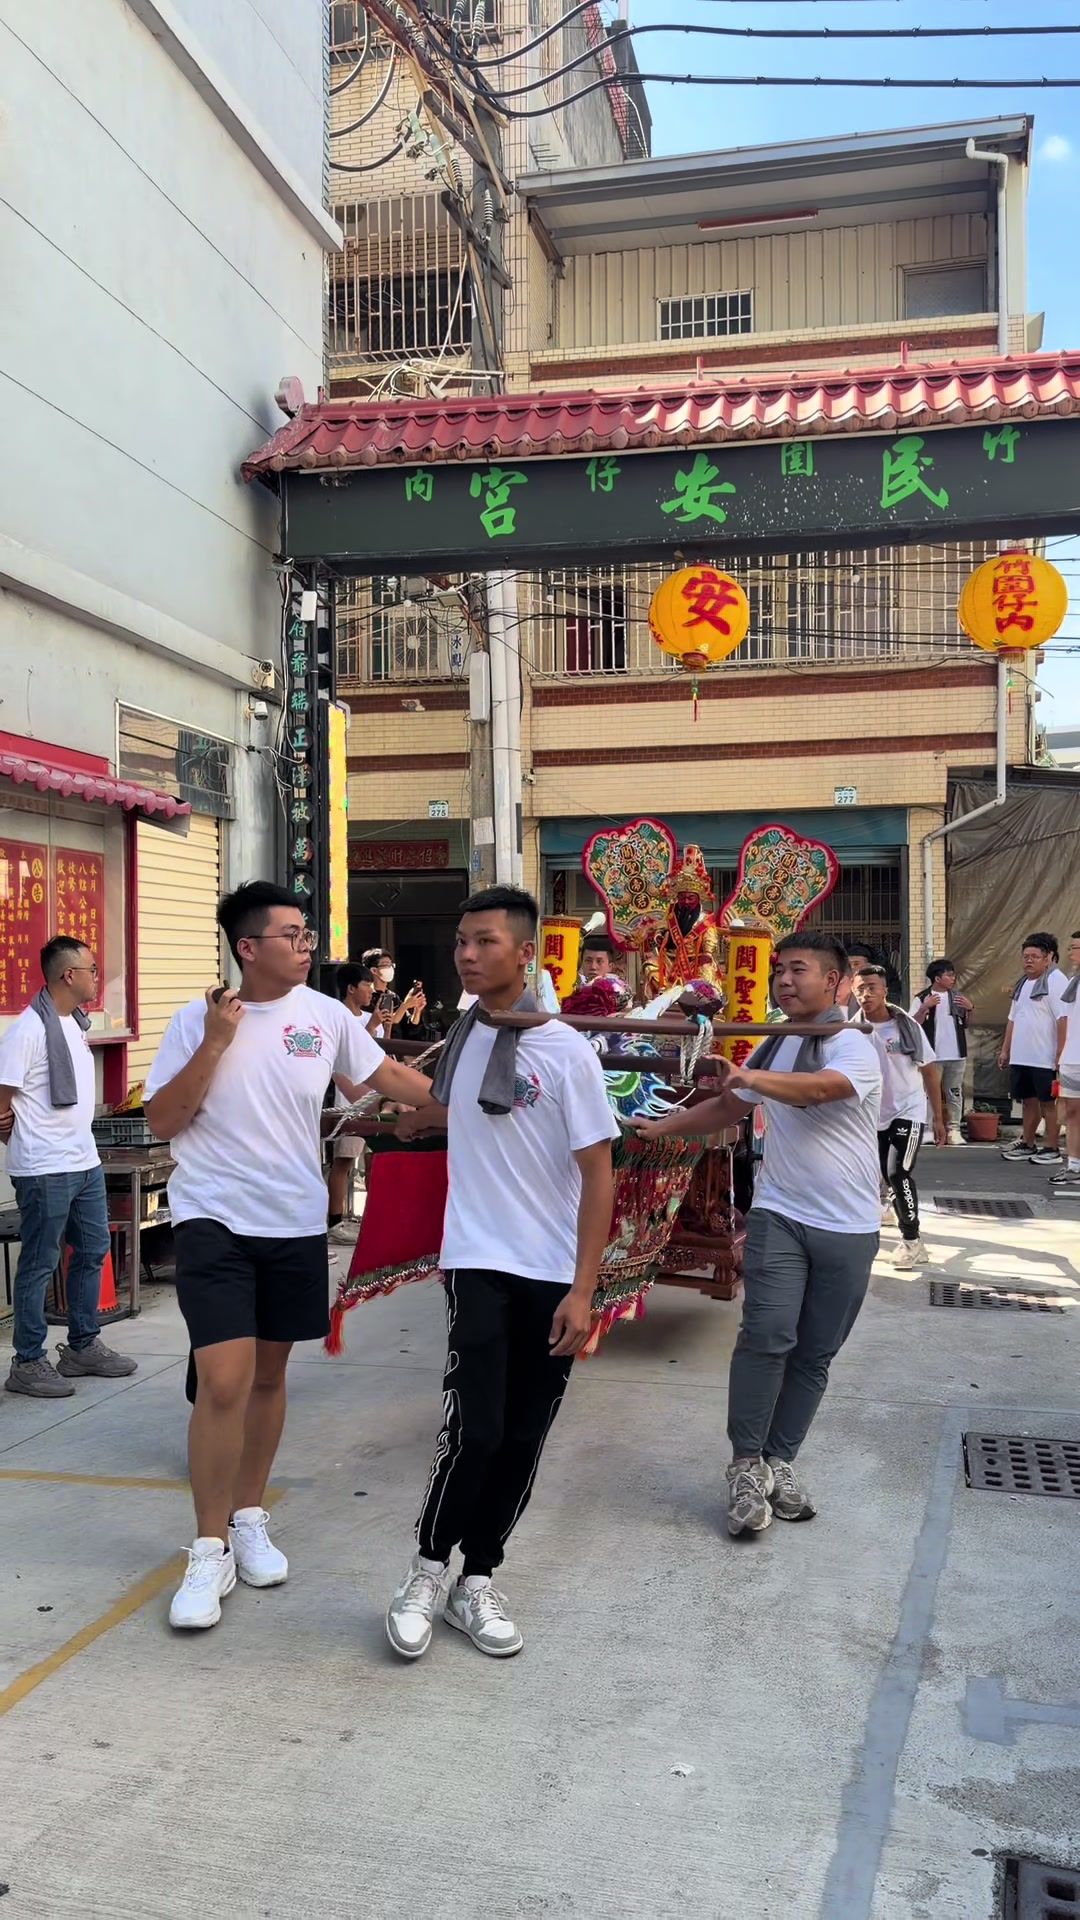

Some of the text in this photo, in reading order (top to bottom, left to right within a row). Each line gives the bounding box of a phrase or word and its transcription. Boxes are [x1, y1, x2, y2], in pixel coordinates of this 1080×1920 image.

[682, 571, 739, 636] 安
[33, 859, 43, 903] 公告
[903, 1178, 914, 1209] adidas
